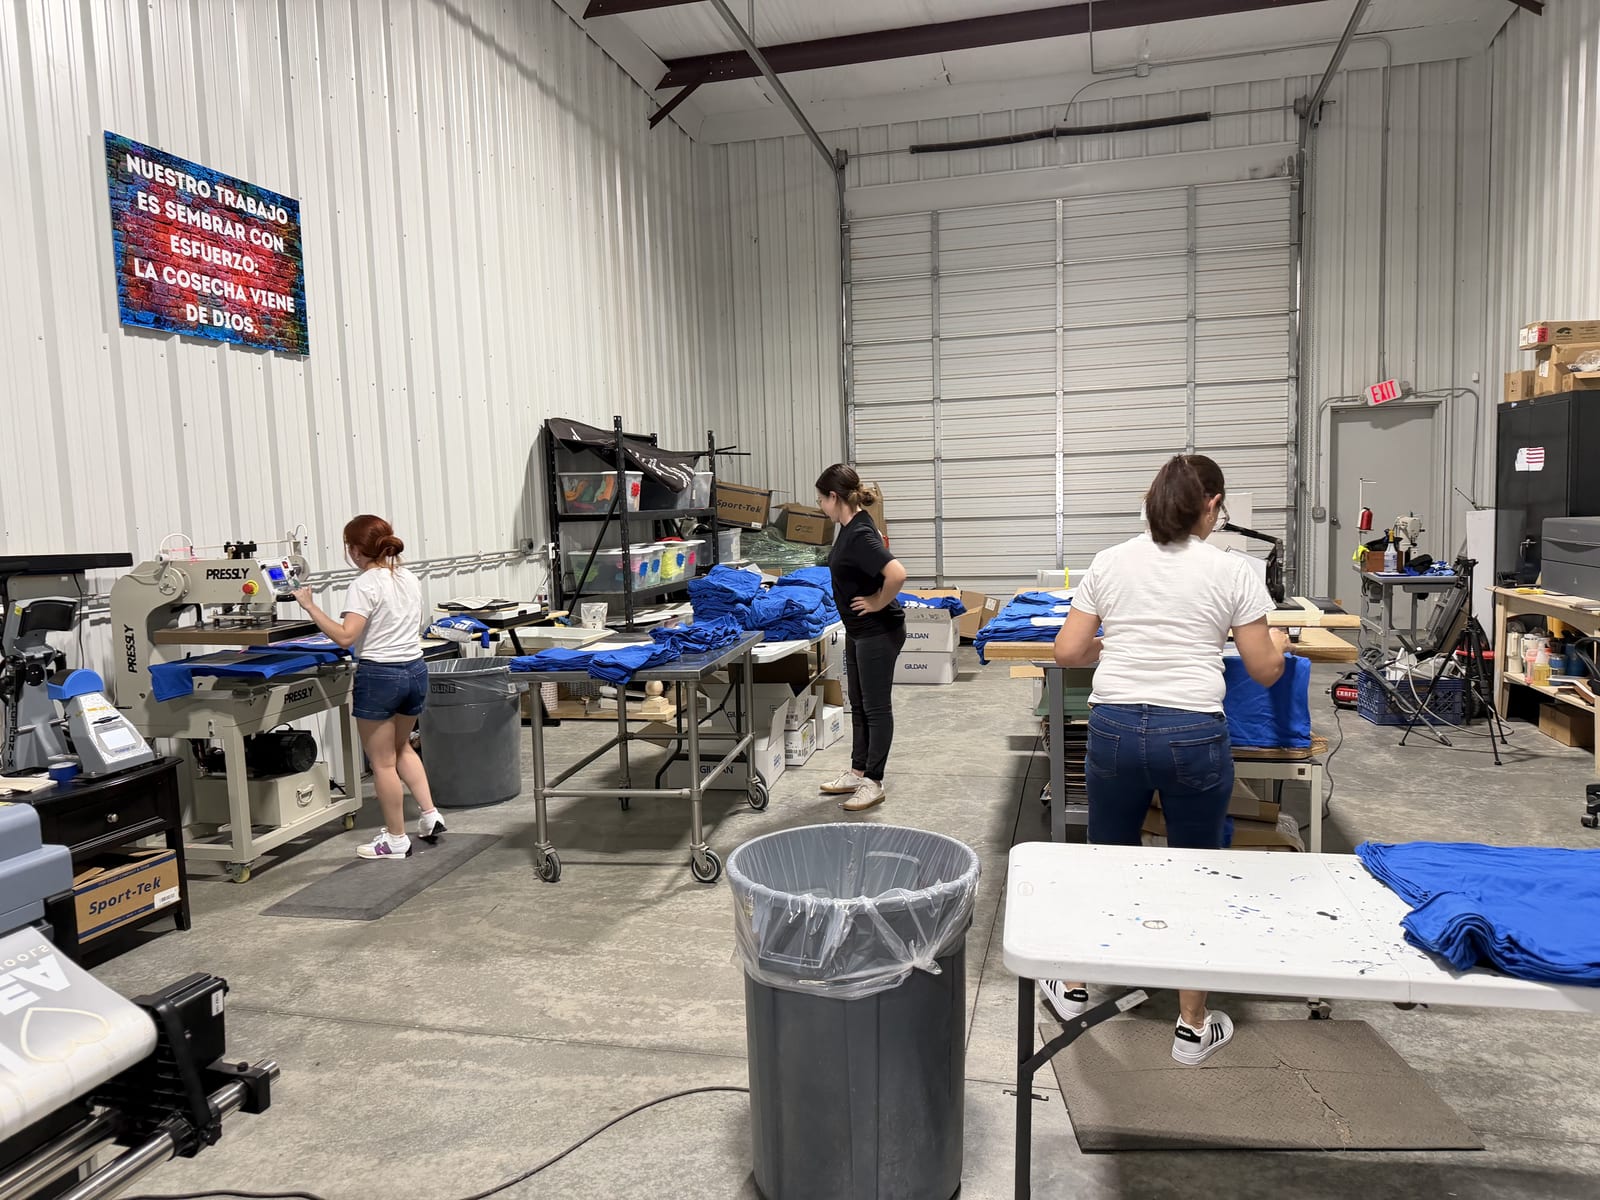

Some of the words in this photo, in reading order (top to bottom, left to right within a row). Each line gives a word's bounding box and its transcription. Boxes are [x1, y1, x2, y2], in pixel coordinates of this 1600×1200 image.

[126, 153, 211, 199] NUESTRO
[214, 184, 288, 225] TRABAJO
[137, 191, 161, 215] ES
[165, 200, 246, 242] SEMBRAR
[250, 228, 284, 253] CON
[170, 235, 259, 277] ESFUERZO;
[134, 258, 158, 281] LA
[162, 266, 247, 302] COSECHA
[249, 287, 295, 313] VIENE
[185, 303, 209, 324] DE
[212, 309, 259, 334] DIOS.
[1370, 380, 1397, 403] EXIT
[717, 499, 762, 513] Sport-Tek
[206, 568, 249, 580] PRESSLY
[124, 624, 137, 673] PRESSLY
[284, 686, 314, 704] PRESSLY
[431, 684, 456, 694] ULINE
[88, 876, 161, 915] Sport-Tek
